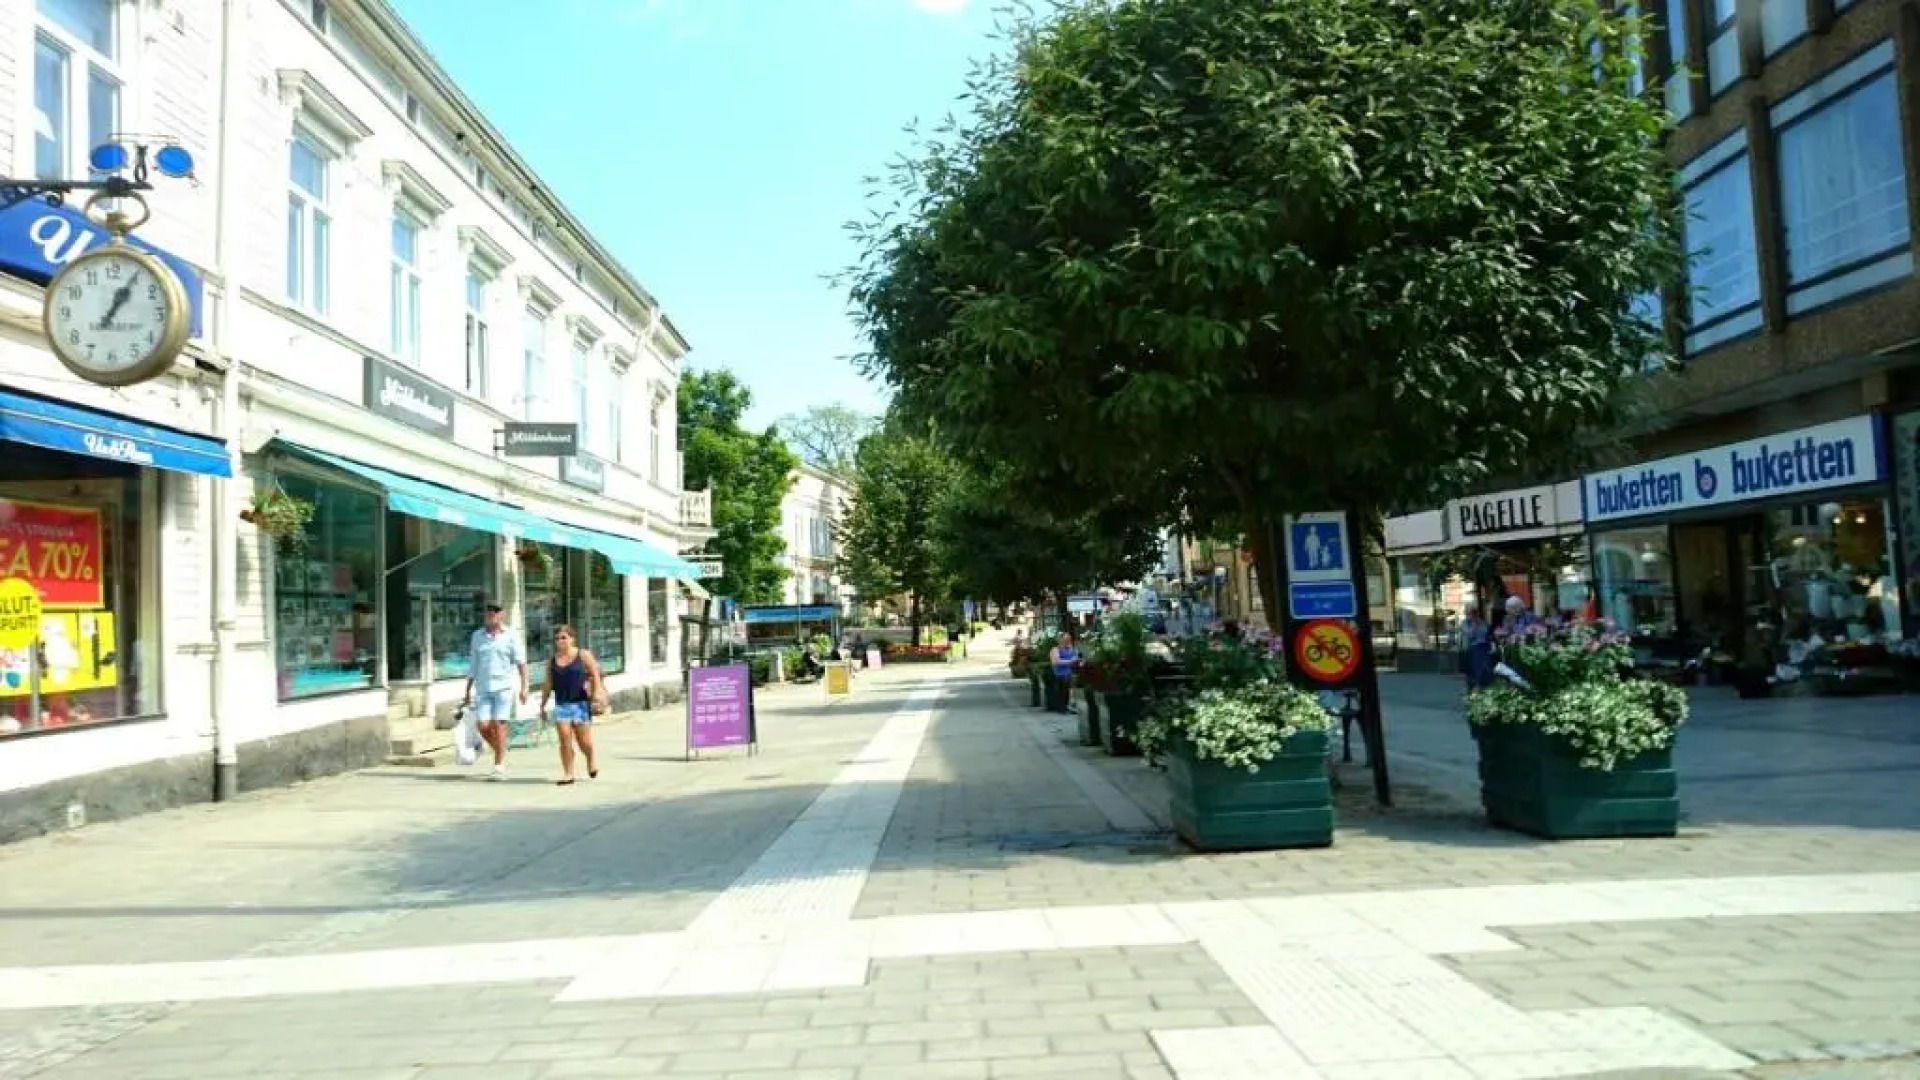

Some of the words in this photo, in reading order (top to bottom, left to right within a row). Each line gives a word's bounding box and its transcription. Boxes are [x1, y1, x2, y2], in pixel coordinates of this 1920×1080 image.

[86, 269, 98, 286] 11
[104, 262, 121, 280] 12
[66, 284, 82, 301] 10
[147, 283, 157, 301] 2
[155, 305, 165, 322] 3
[69, 328, 80, 346] 8
[1595, 469, 1683, 515] buketten
[1731, 435, 1856, 495] buketten
[1459, 494, 1545, 536] PAGELLE
[38, 541, 94, 581] 70%
